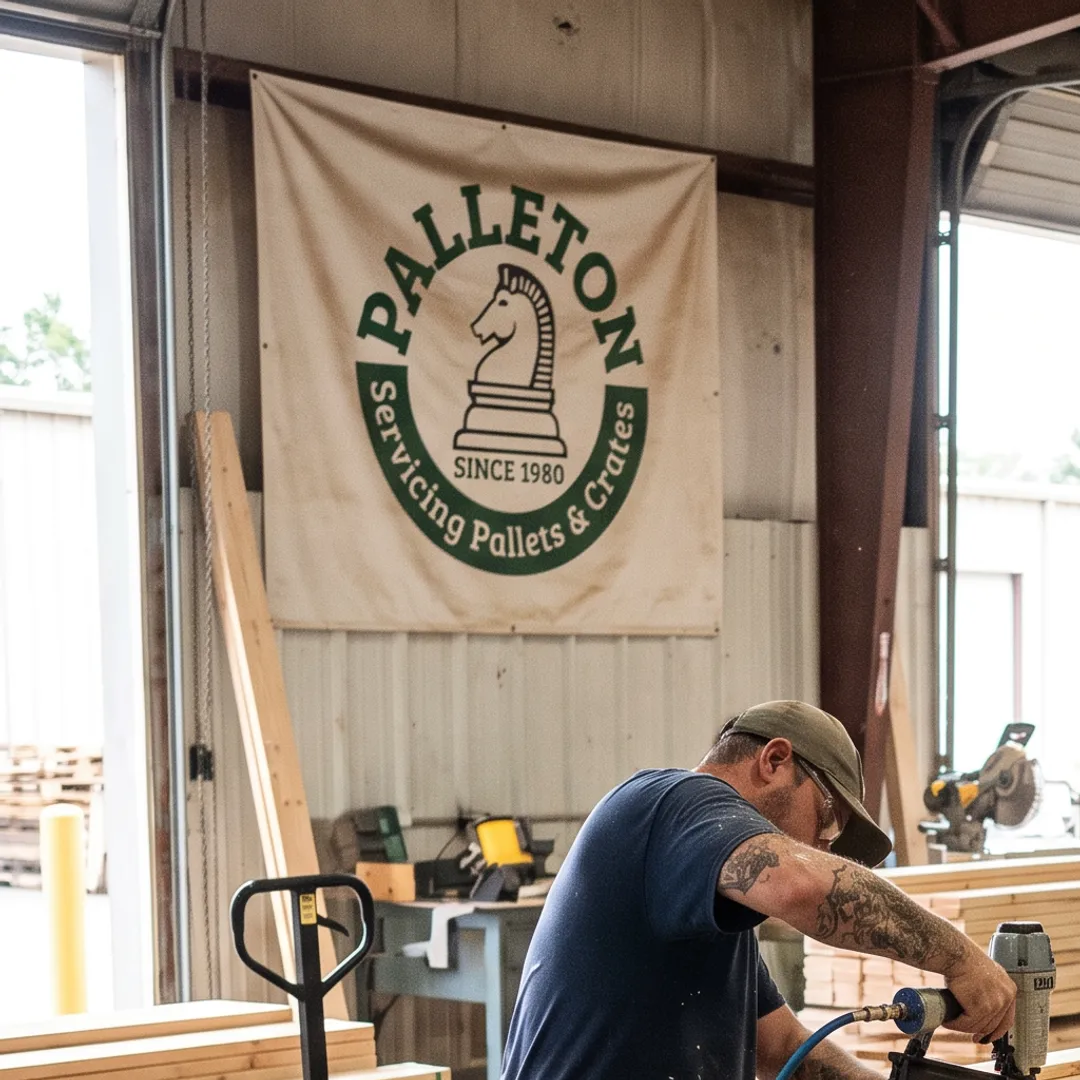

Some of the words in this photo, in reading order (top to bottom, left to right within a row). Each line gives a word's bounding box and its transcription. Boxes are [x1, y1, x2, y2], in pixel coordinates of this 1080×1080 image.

[356, 184, 644, 373] PALLETON
[370, 380, 466, 546] Servicing
[469, 519, 566, 558] Pallets
[567, 505, 591, 536] &
[584, 400, 636, 511] Crates
[453, 456, 515, 482] SINCE
[521, 462, 565, 485] 1980
